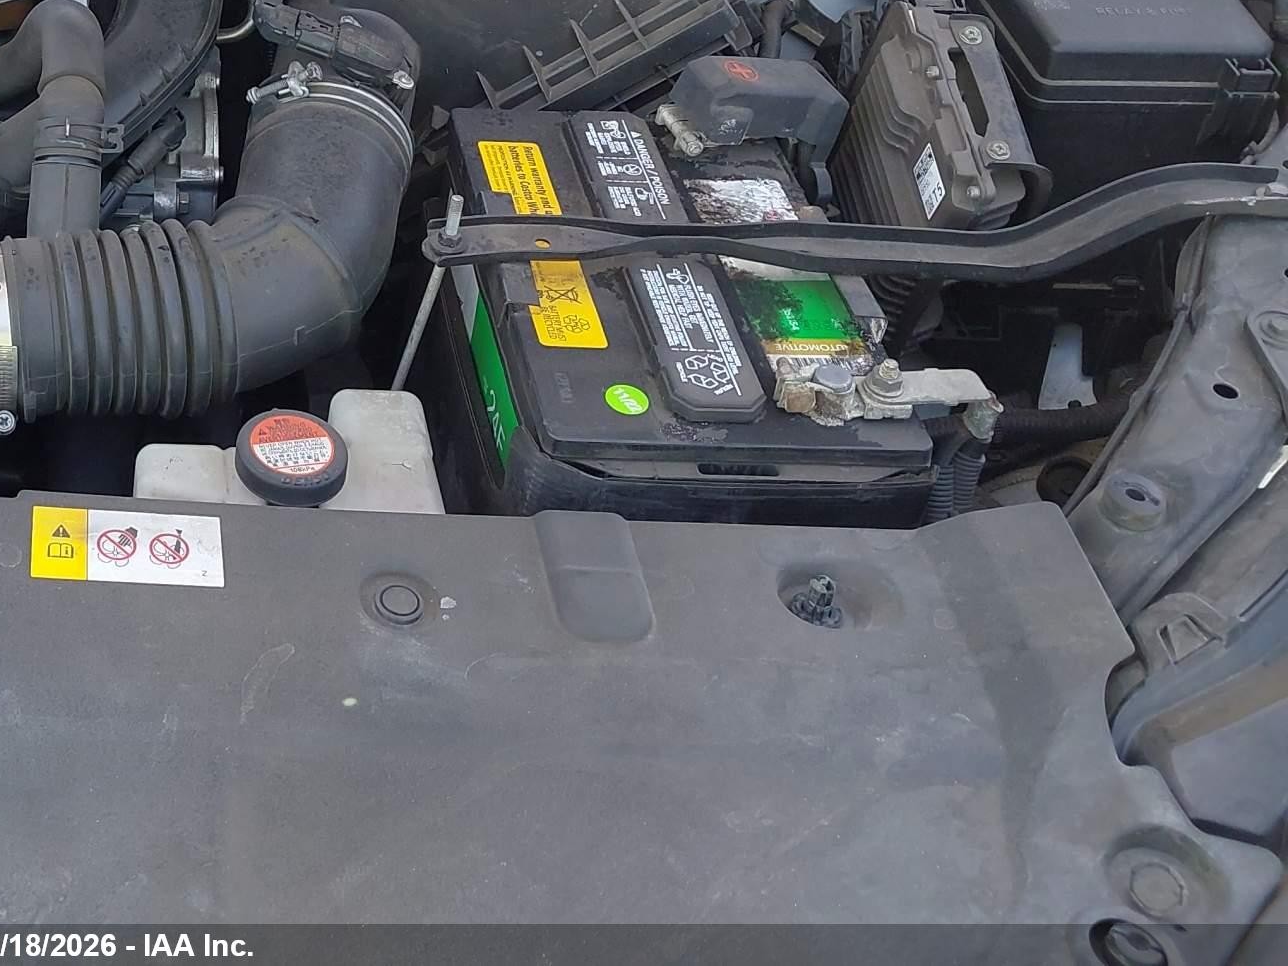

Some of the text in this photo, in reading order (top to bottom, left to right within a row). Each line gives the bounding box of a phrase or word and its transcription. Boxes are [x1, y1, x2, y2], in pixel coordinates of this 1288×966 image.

[508, 146, 523, 172] batteries
[520, 181, 533, 201] Costco
[523, 146, 537, 167] Return
[531, 167, 547, 195] warranty
[540, 195, 554, 209] and
[633, 139, 655, 169] DANGER
[649, 176, 671, 205] POISON
